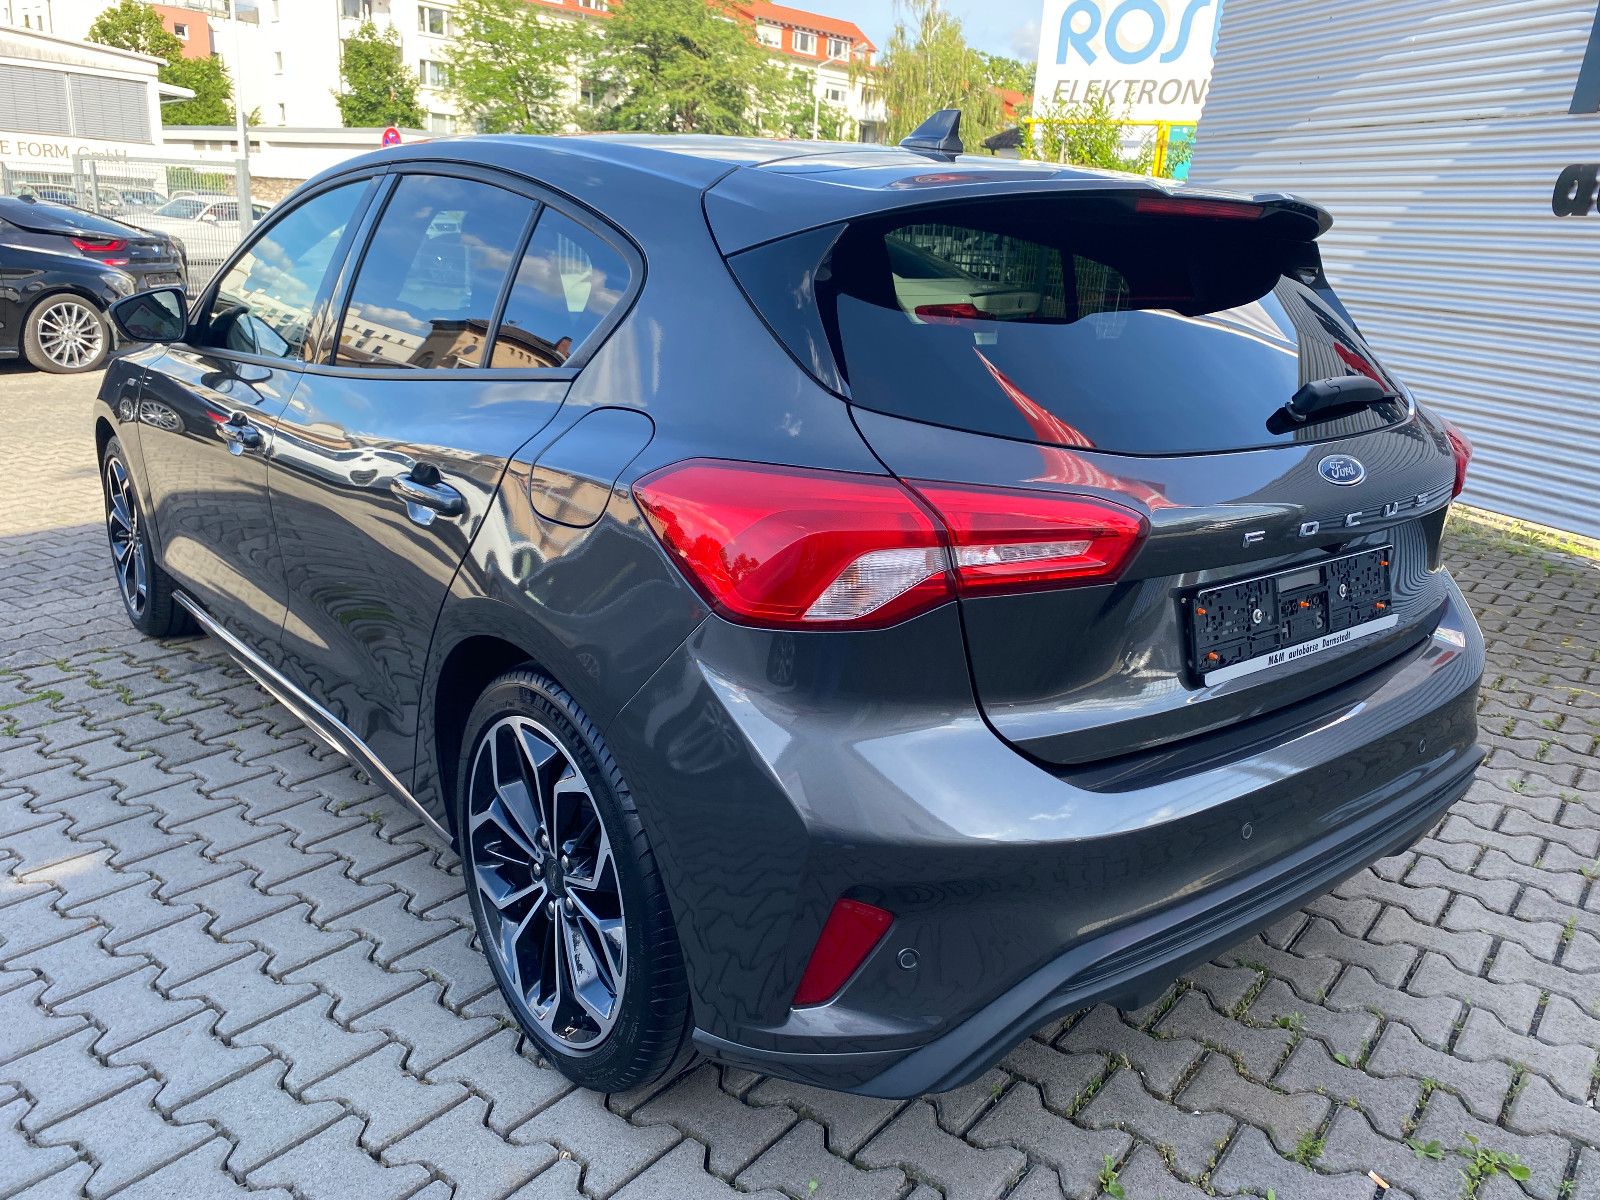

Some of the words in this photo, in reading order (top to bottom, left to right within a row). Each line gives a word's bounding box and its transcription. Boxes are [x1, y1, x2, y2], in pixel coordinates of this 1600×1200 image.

[1056, 0, 1225, 65] ROS
[17, 142, 69, 158] FORM
[1552, 164, 1600, 217] a
[1330, 460, 1356, 478] Ford
[1242, 492, 1429, 548] FOCUS
[1268, 652, 1285, 666] M&M
